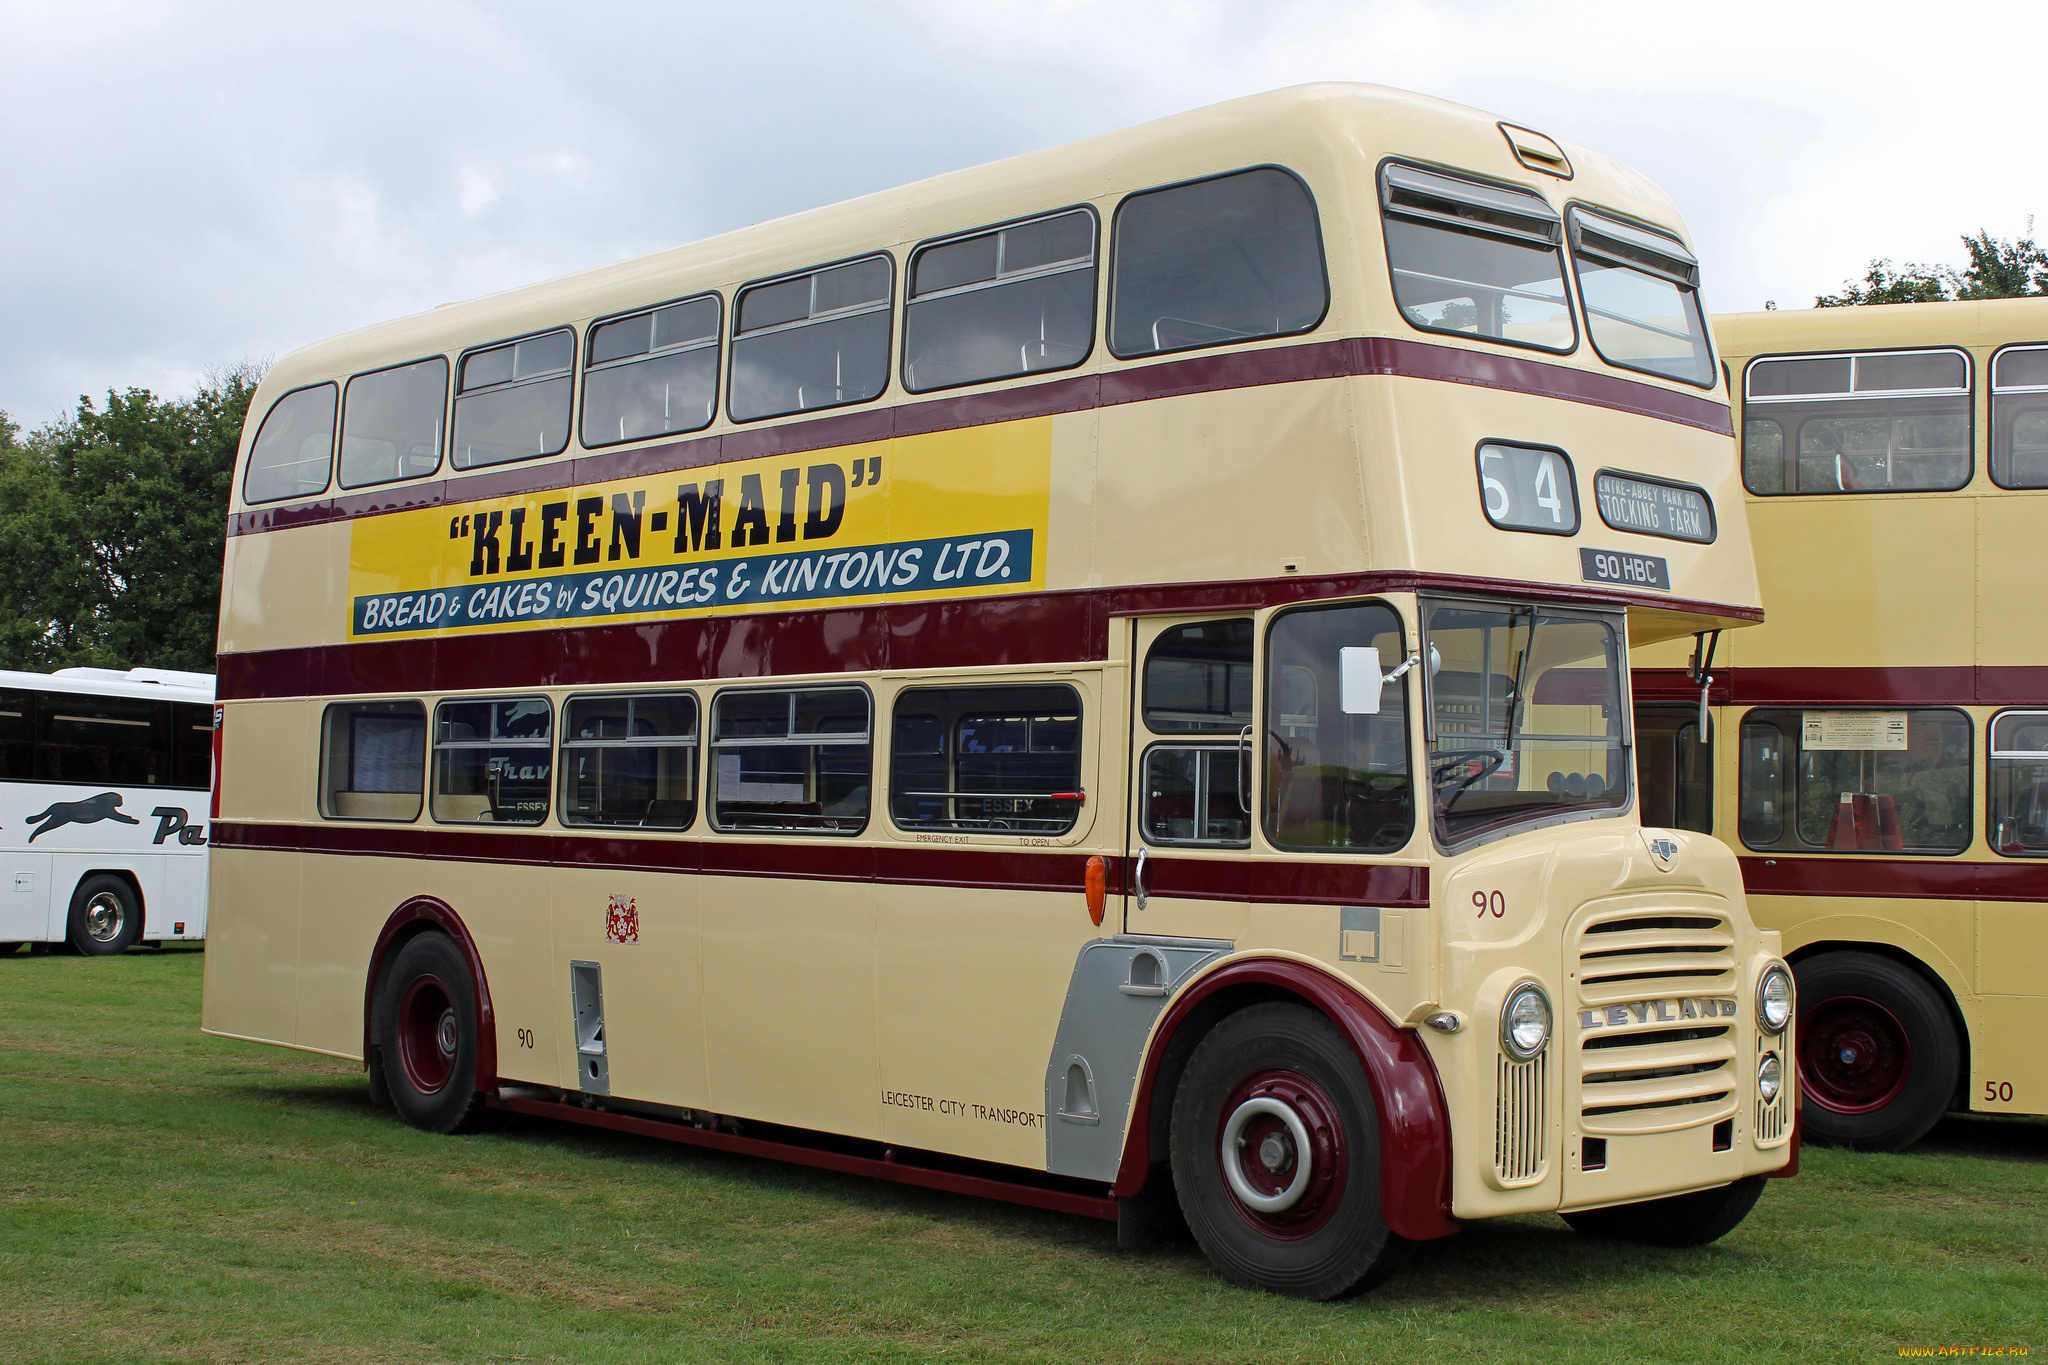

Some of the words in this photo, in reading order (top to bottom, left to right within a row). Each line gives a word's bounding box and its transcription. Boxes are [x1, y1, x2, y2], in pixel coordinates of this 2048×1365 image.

[1662, 489, 1683, 507] PARK
[1685, 494, 1698, 510] RD.
[1669, 507, 1702, 536] FARM
[1595, 554, 1620, 579] 90
[1622, 557, 1657, 583] HBC
[363, 592, 447, 630] BREAD
[448, 595, 461, 617] &
[468, 581, 553, 619] CAKES
[556, 584, 579, 612] by
[581, 567, 718, 613] SQUIRES
[726, 562, 751, 599] &
[760, 547, 923, 595] KINTONS
[933, 538, 1011, 582] LTD.
[982, 798, 1034, 813] ESSEX
[916, 834, 953, 844] EMERGENCY
[954, 836, 970, 845] EXIT
[1019, 837, 1030, 846] TO
[1031, 838, 1050, 848] OPEN
[1471, 889, 1506, 919] 90
[1577, 998, 1737, 1029] LEYLAND
[517, 1028, 534, 1049] 90
[1984, 1081, 2014, 1102] 50
[881, 1090, 935, 1112] LEICESTER
[939, 1099, 966, 1117] CITY
[972, 1104, 1045, 1129] TRANSPORT
